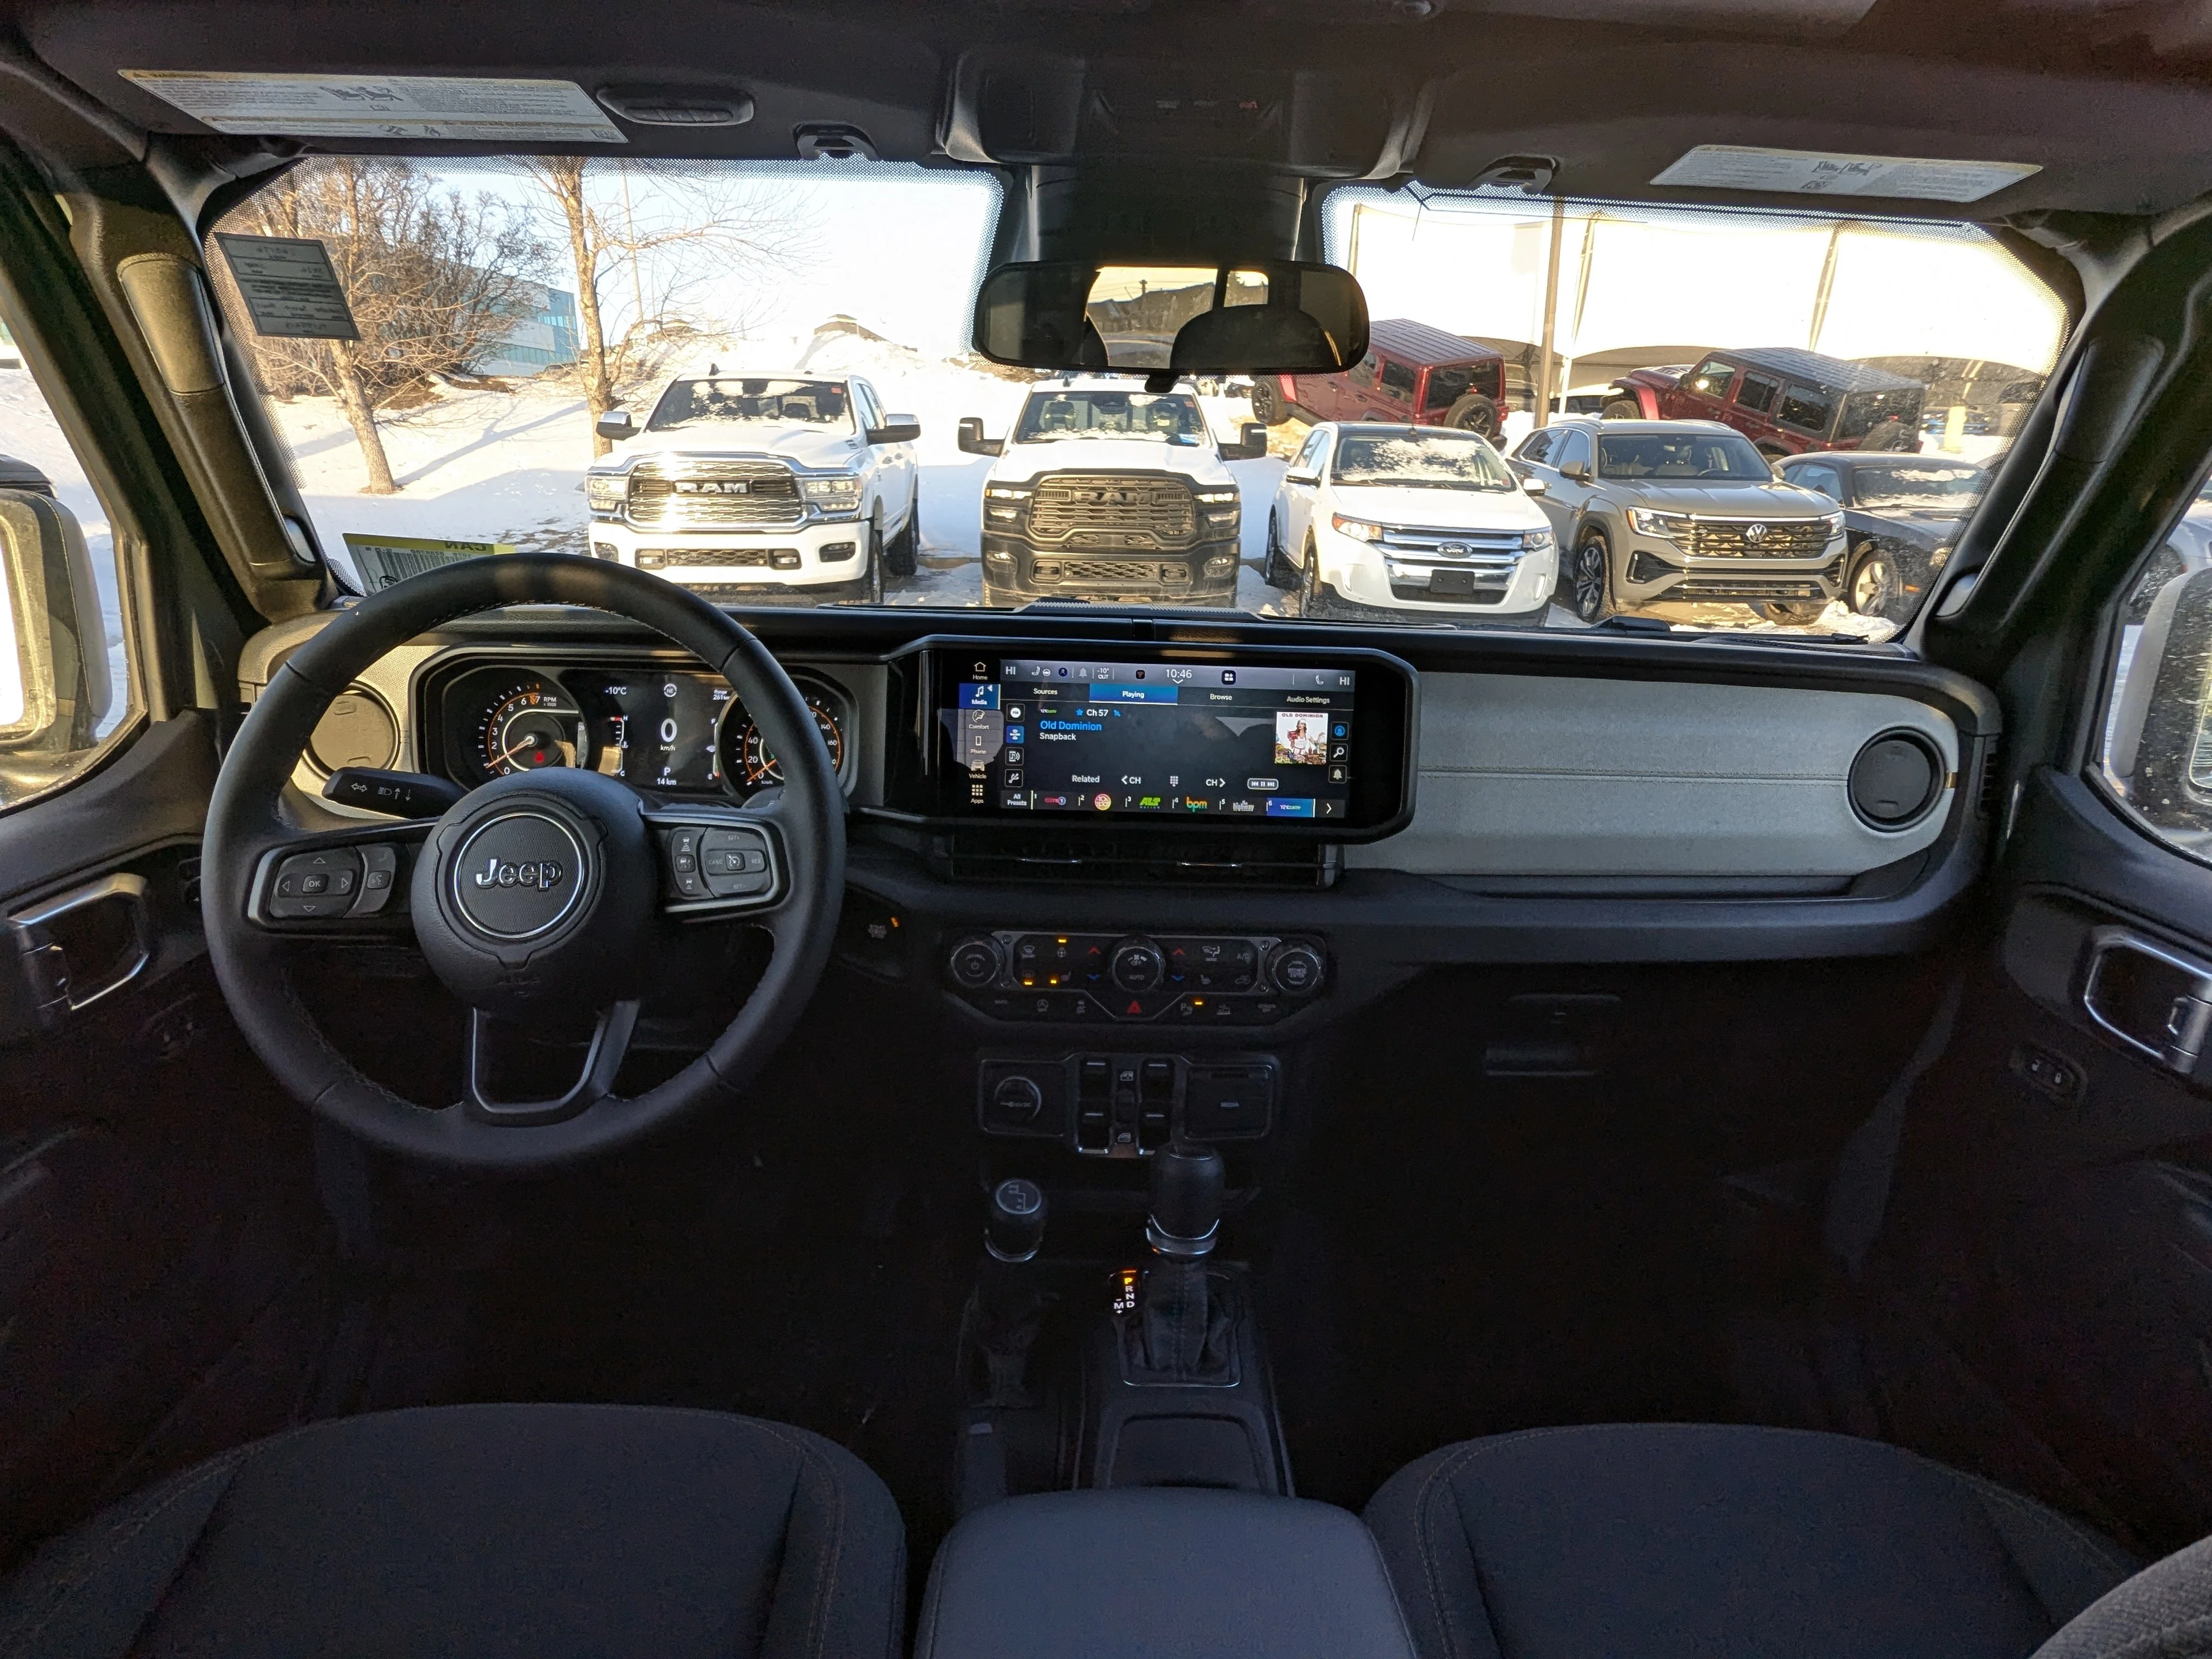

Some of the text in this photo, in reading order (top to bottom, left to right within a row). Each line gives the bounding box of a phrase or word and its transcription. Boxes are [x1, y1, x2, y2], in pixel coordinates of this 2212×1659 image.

[675, 482, 747, 493] RAM
[1074, 492, 1155, 503] RAM
[1006, 666, 1015, 675] HI
[1166, 669, 1192, 678] 10:46
[1339, 676, 1350, 685] HI
[605, 686, 627, 695] -10°C
[521, 697, 527, 706] 6
[508, 703, 514, 712] 5
[498, 714, 504, 722] 4
[661, 718, 678, 742] 0
[1040, 720, 1102, 731] Old Dominion
[493, 727, 498, 736] 3
[1040, 732, 1076, 741] Snapback
[492, 741, 497, 749] 2
[664, 767, 670, 776] P
[1072, 775, 1100, 783] Related
[1206, 778, 1218, 787] CH
[1139, 797, 1160, 806] ALT
[1186, 797, 1207, 812] bpm
[1233, 803, 1255, 811] highway
[476, 859, 563, 891] Jeep
